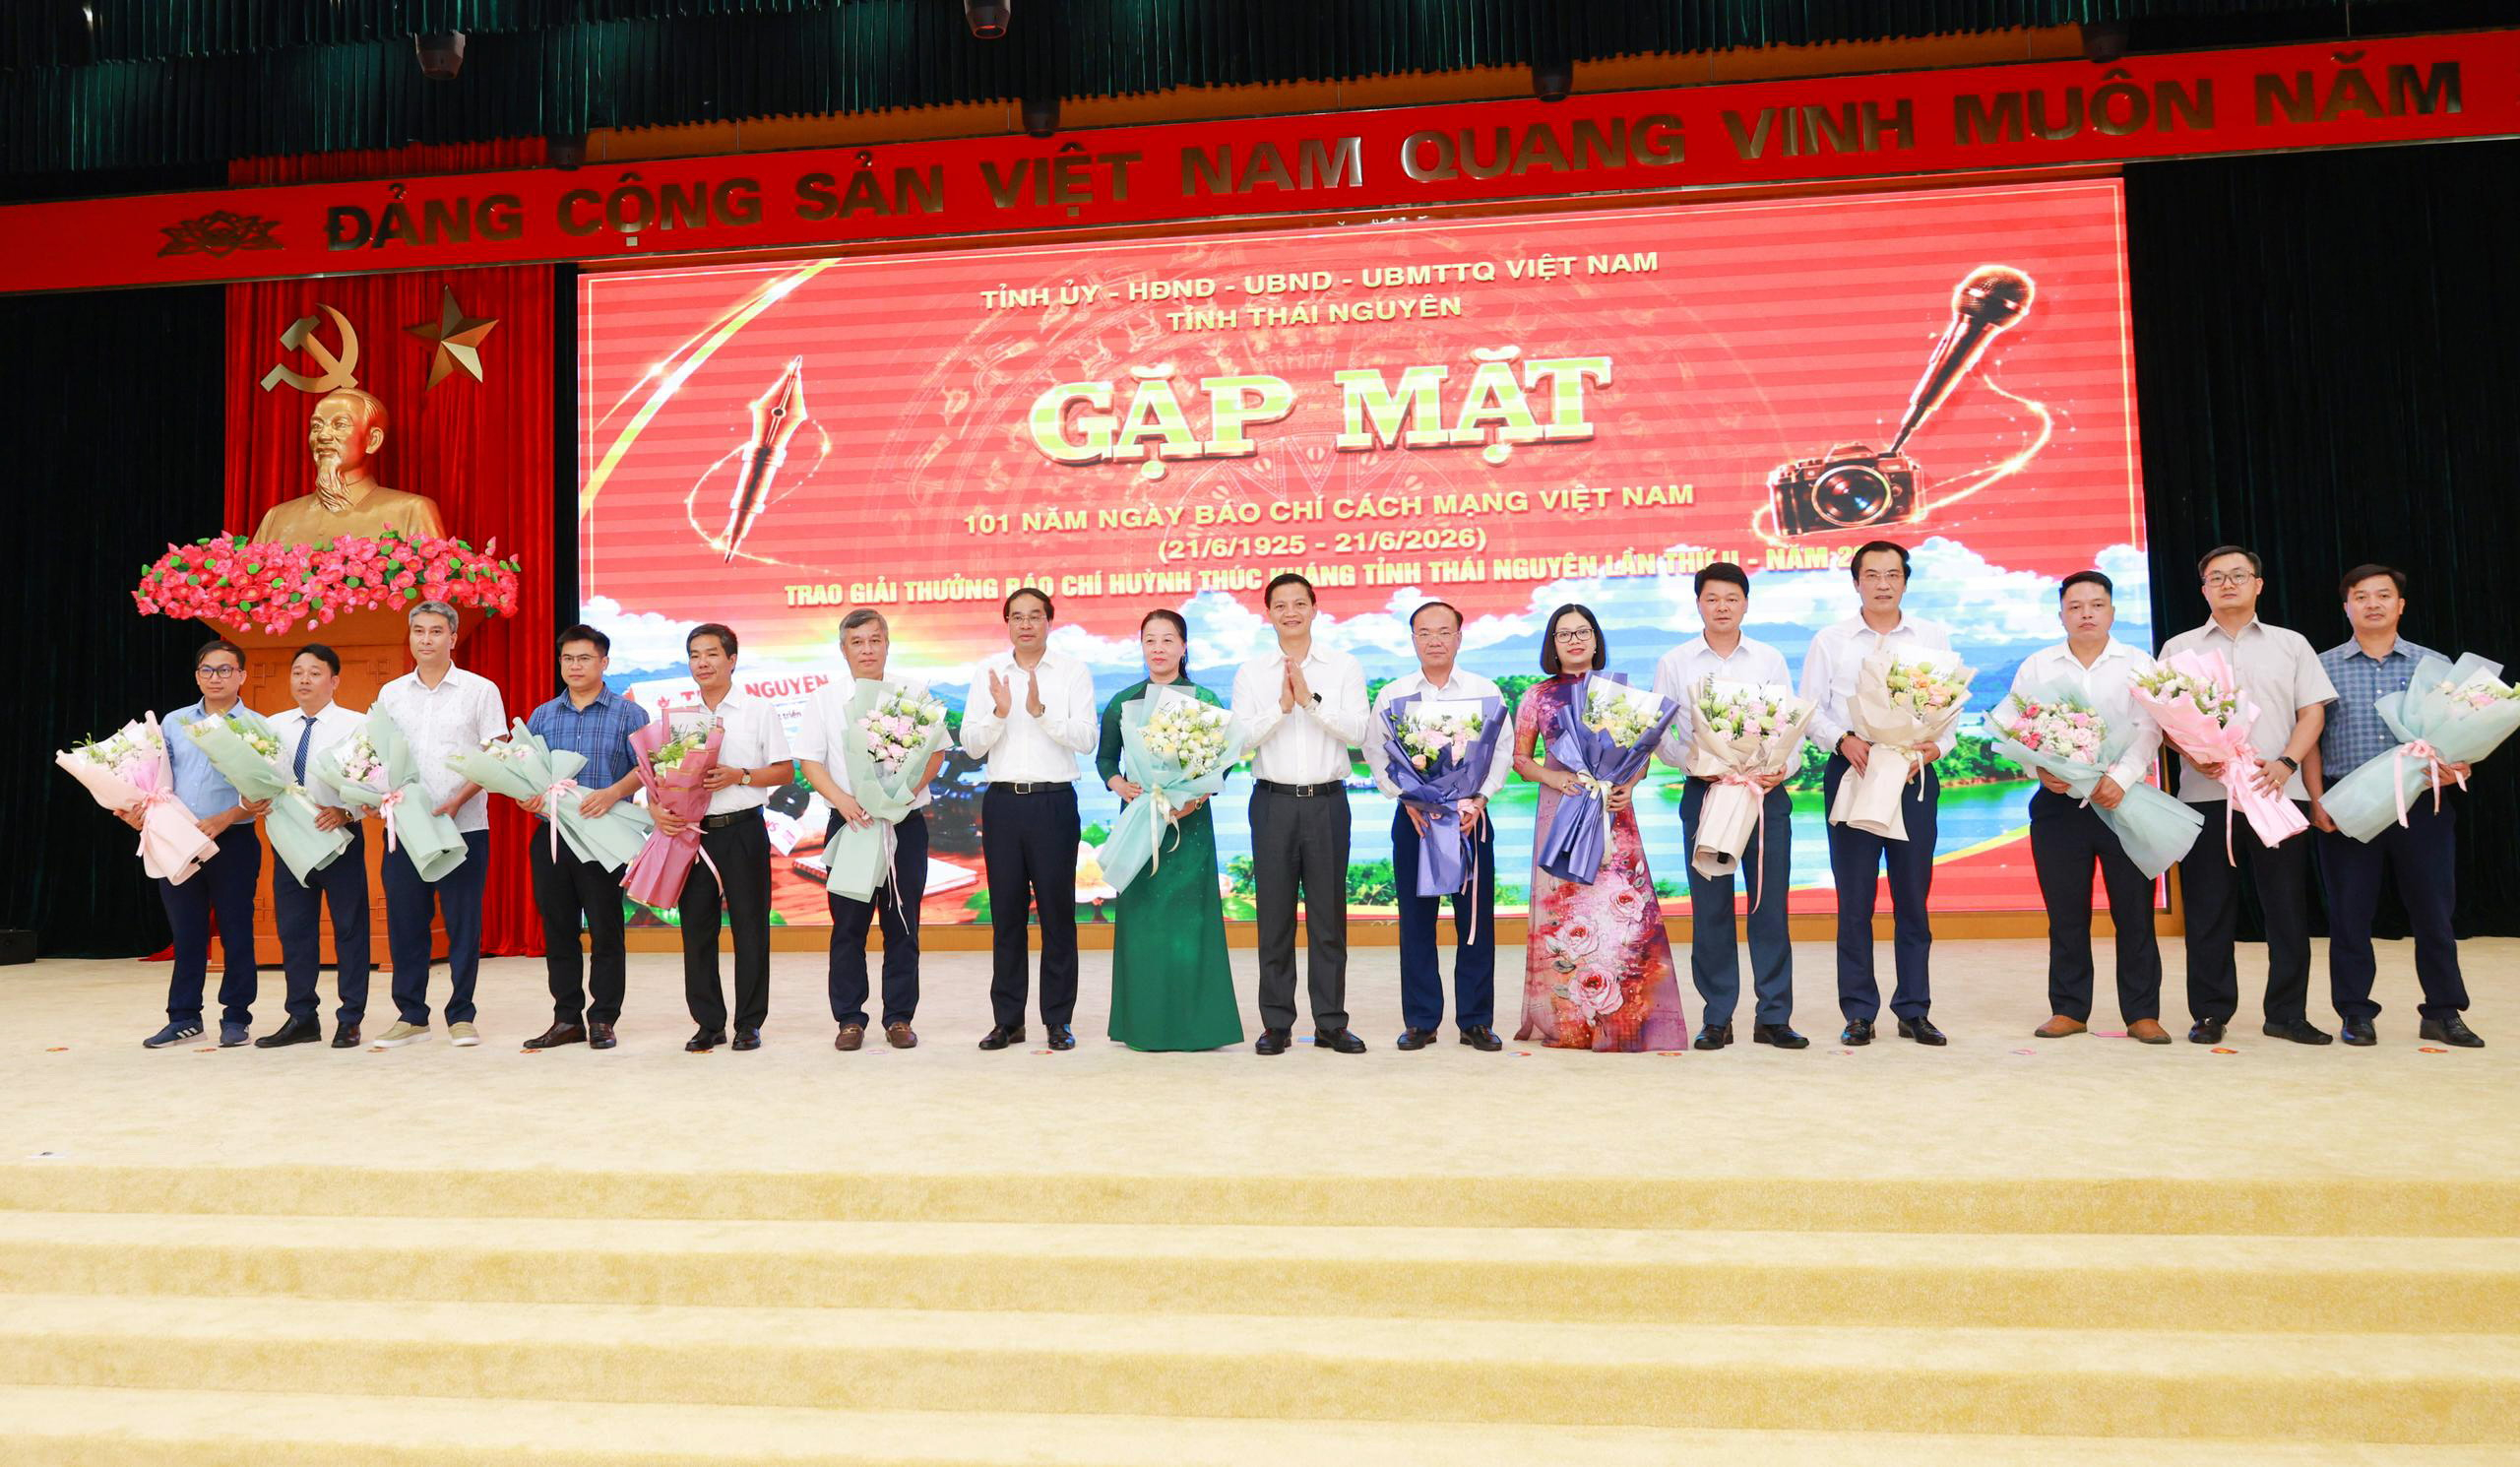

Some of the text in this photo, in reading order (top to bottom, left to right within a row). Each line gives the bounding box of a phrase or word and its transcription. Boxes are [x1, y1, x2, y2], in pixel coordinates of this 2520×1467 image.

[325, 50, 2464, 252] ĐẢNG CỘNG SẢN VIỆT NAM QUANG VINH MUÔN NĂM
[979, 283, 1048, 310] TỈNH
[1060, 280, 1101, 305] ỦY
[1129, 279, 1217, 301] HĐND
[1244, 270, 1333, 295] UBND
[1362, 262, 1495, 288] UBMTTQ
[1506, 253, 1578, 282] VIỆT
[1588, 252, 1660, 275] NAM
[1166, 294, 1462, 332] TỈNH THÁI NGUYÊN
[1028, 345, 1612, 482] GẶP MẶT
[964, 480, 1695, 535] 101 NĂM NGÀY BÁO CHÍ CÁCH MẠNG VIỆT NAM
[1158, 534, 1306, 563] (21/6/1925
[1335, 527, 1487, 553] 21/6/2026)
[785, 583, 844, 606] TRAO
[850, 575, 897, 605] GIẢI
[904, 572, 999, 602] THƯỞNG
[1005, 573, 1054, 599] BÁO
[1061, 570, 1102, 597] CHÍ
[1109, 567, 1191, 596] HUỲNH
[1198, 563, 1263, 591] THÚC
[1270, 562, 1355, 588] ÁNG
[1362, 557, 1421, 586] TỈNH
[1427, 555, 1486, 583] THÁI
[1492, 547, 1599, 580] NGUYÊN
[1606, 546, 1656, 577] LẦN
[1666, 547, 1717, 573] THỨ
[1766, 544, 1829, 571] NĂM
[1837, 545, 1863, 568] 2
